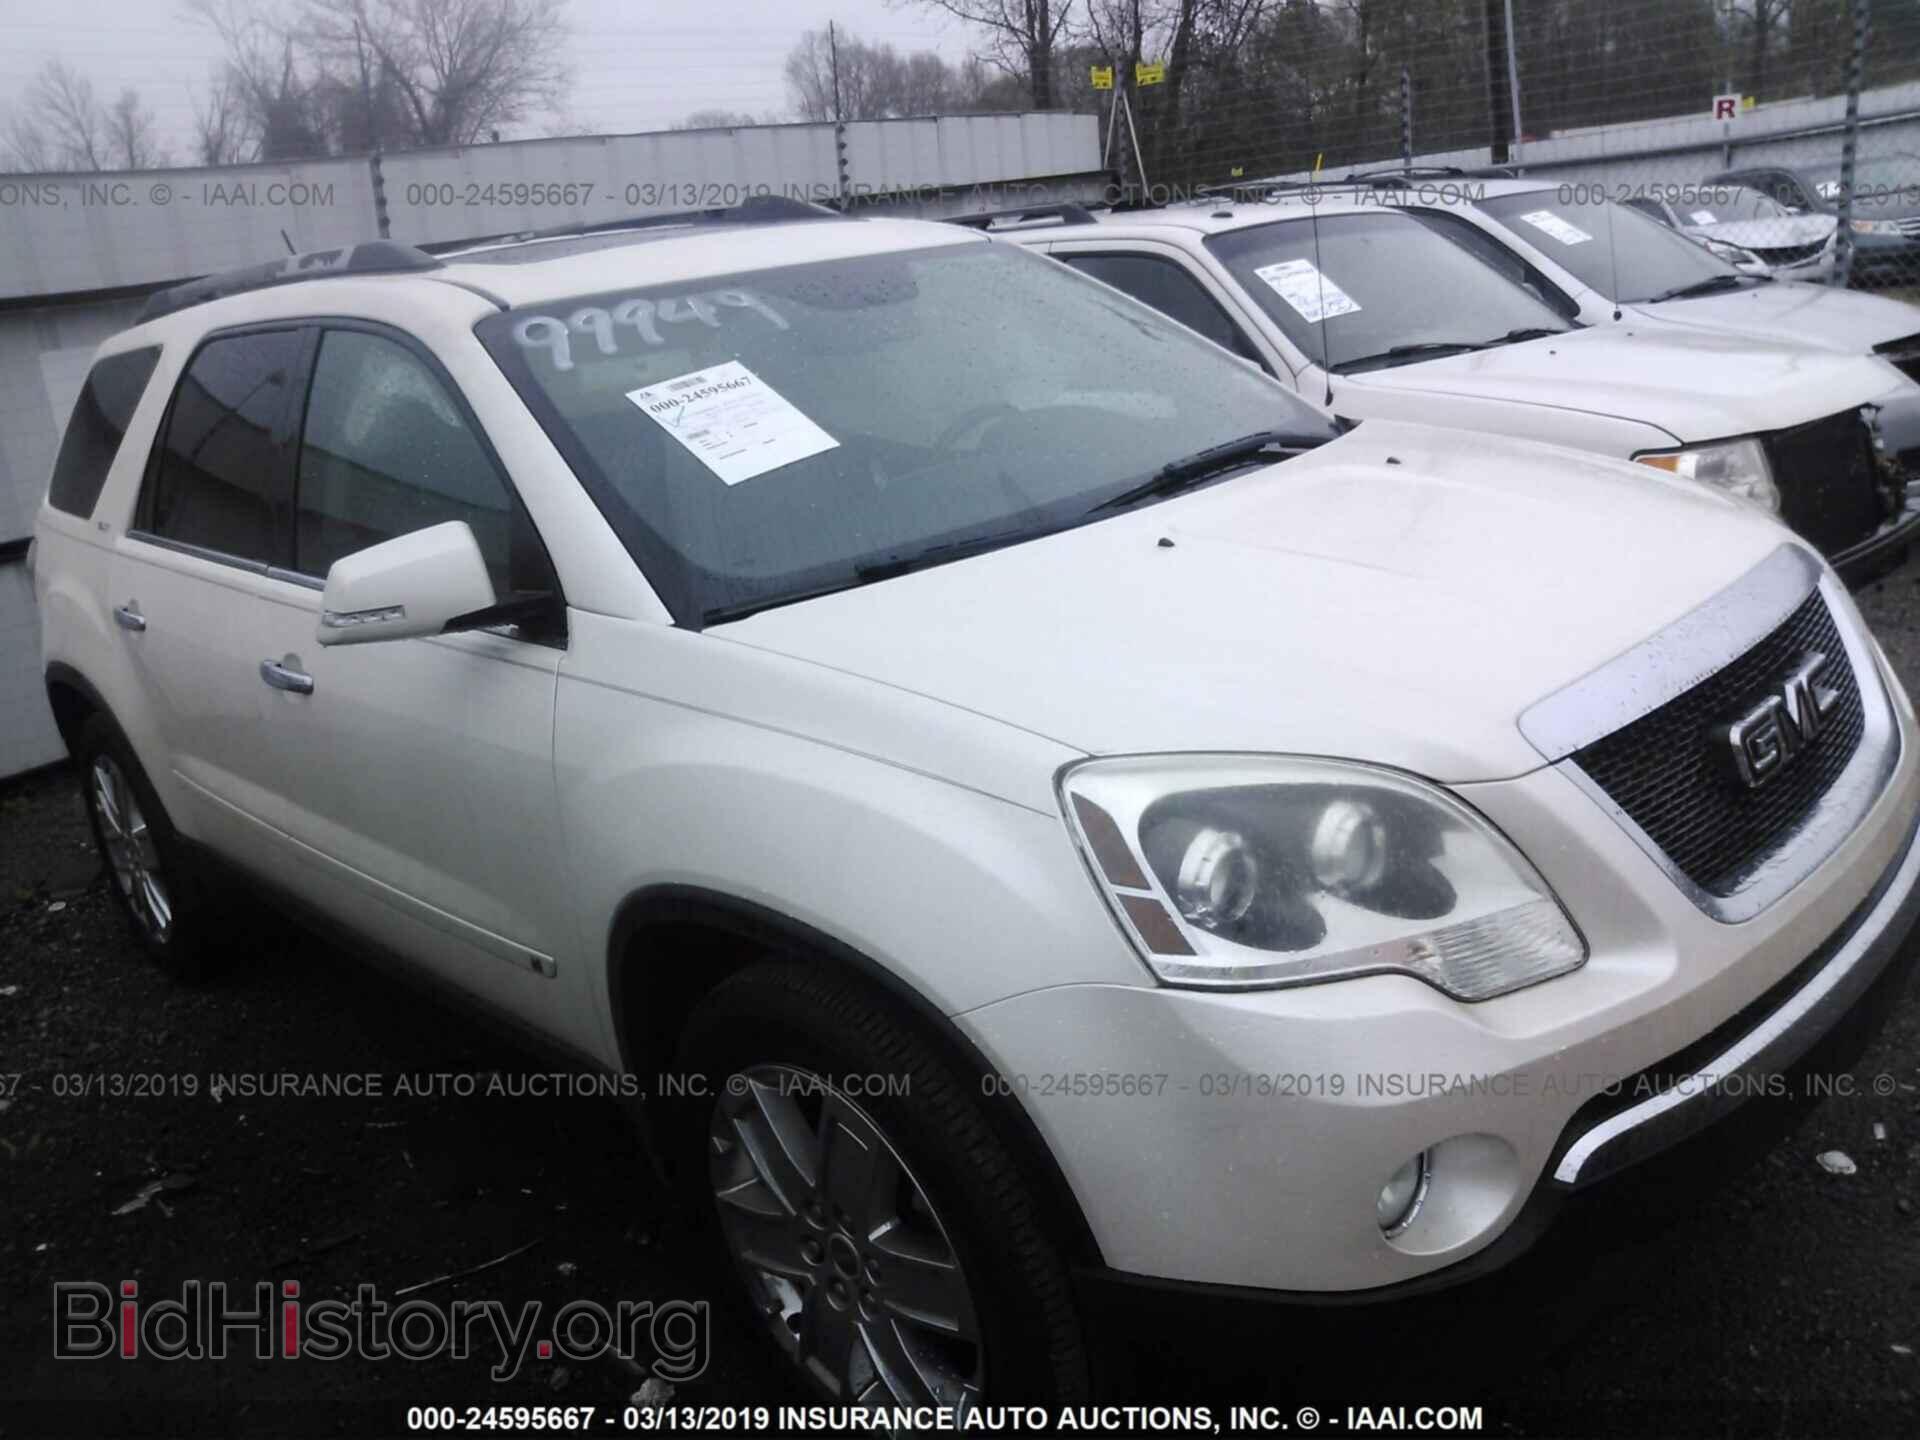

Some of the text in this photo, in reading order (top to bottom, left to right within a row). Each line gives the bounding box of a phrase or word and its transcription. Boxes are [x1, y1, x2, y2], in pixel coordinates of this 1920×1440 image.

[1716, 99, 1736, 120] R
[512, 290, 790, 371] 99949
[650, 376, 752, 413] 000-24595667
